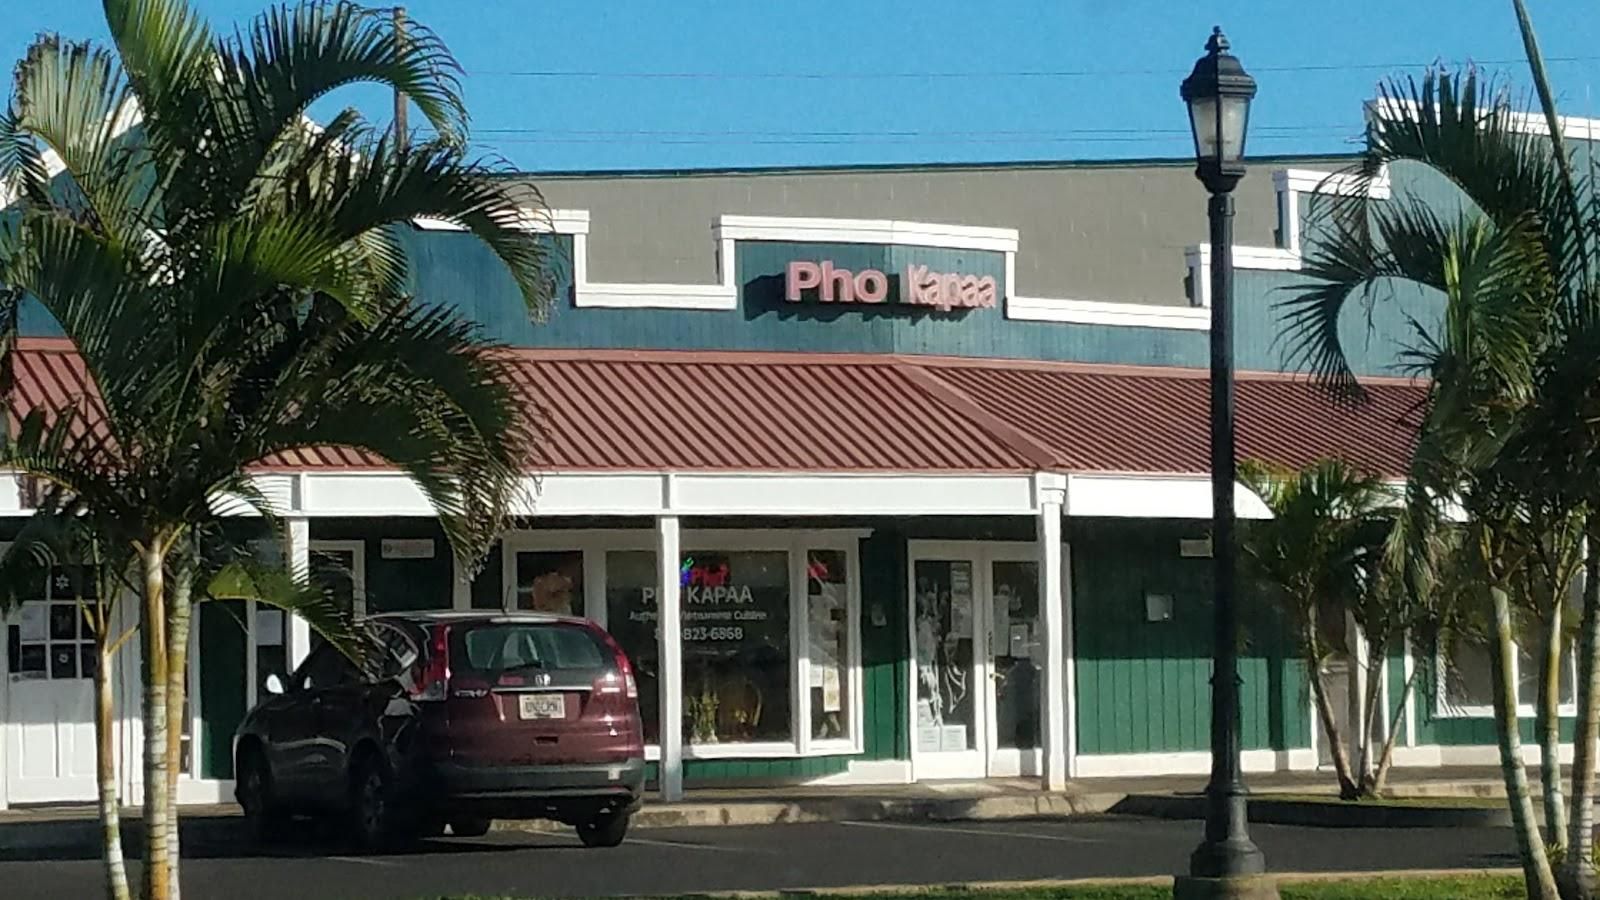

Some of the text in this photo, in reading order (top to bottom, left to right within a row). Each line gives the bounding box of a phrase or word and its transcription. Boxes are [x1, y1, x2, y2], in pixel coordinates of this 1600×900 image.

[785, 260, 996, 311] Pho Kapaa
[687, 585, 753, 604] KAPAA
